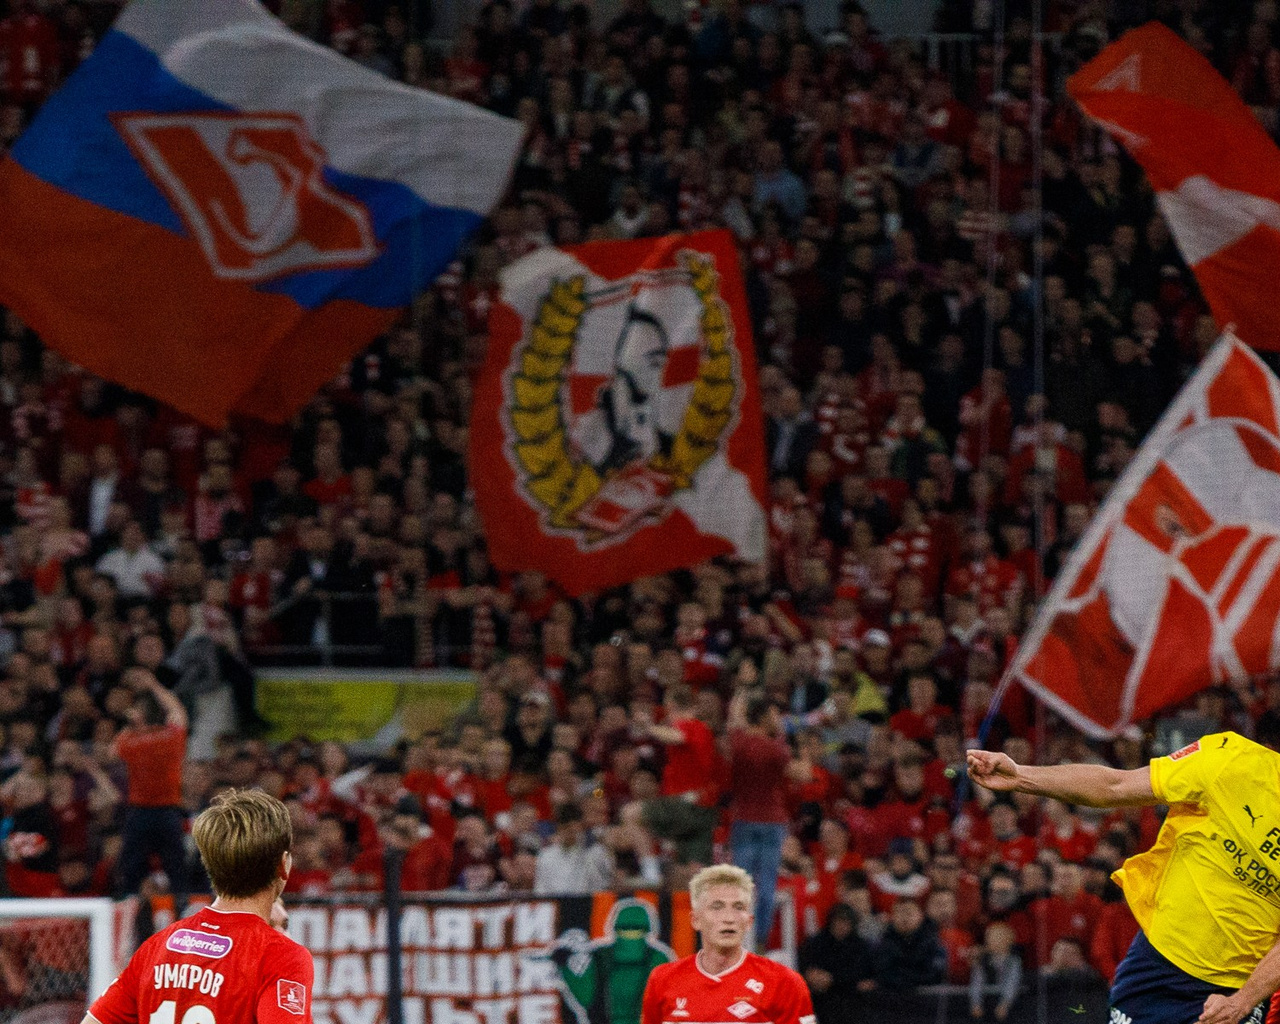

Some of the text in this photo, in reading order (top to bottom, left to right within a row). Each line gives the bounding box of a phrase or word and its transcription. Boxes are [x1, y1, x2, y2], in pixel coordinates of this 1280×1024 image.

[1223, 838, 1248, 864] ФК
[172, 935, 226, 953] wildberries
[154, 963, 224, 998] УМЯРОВ
